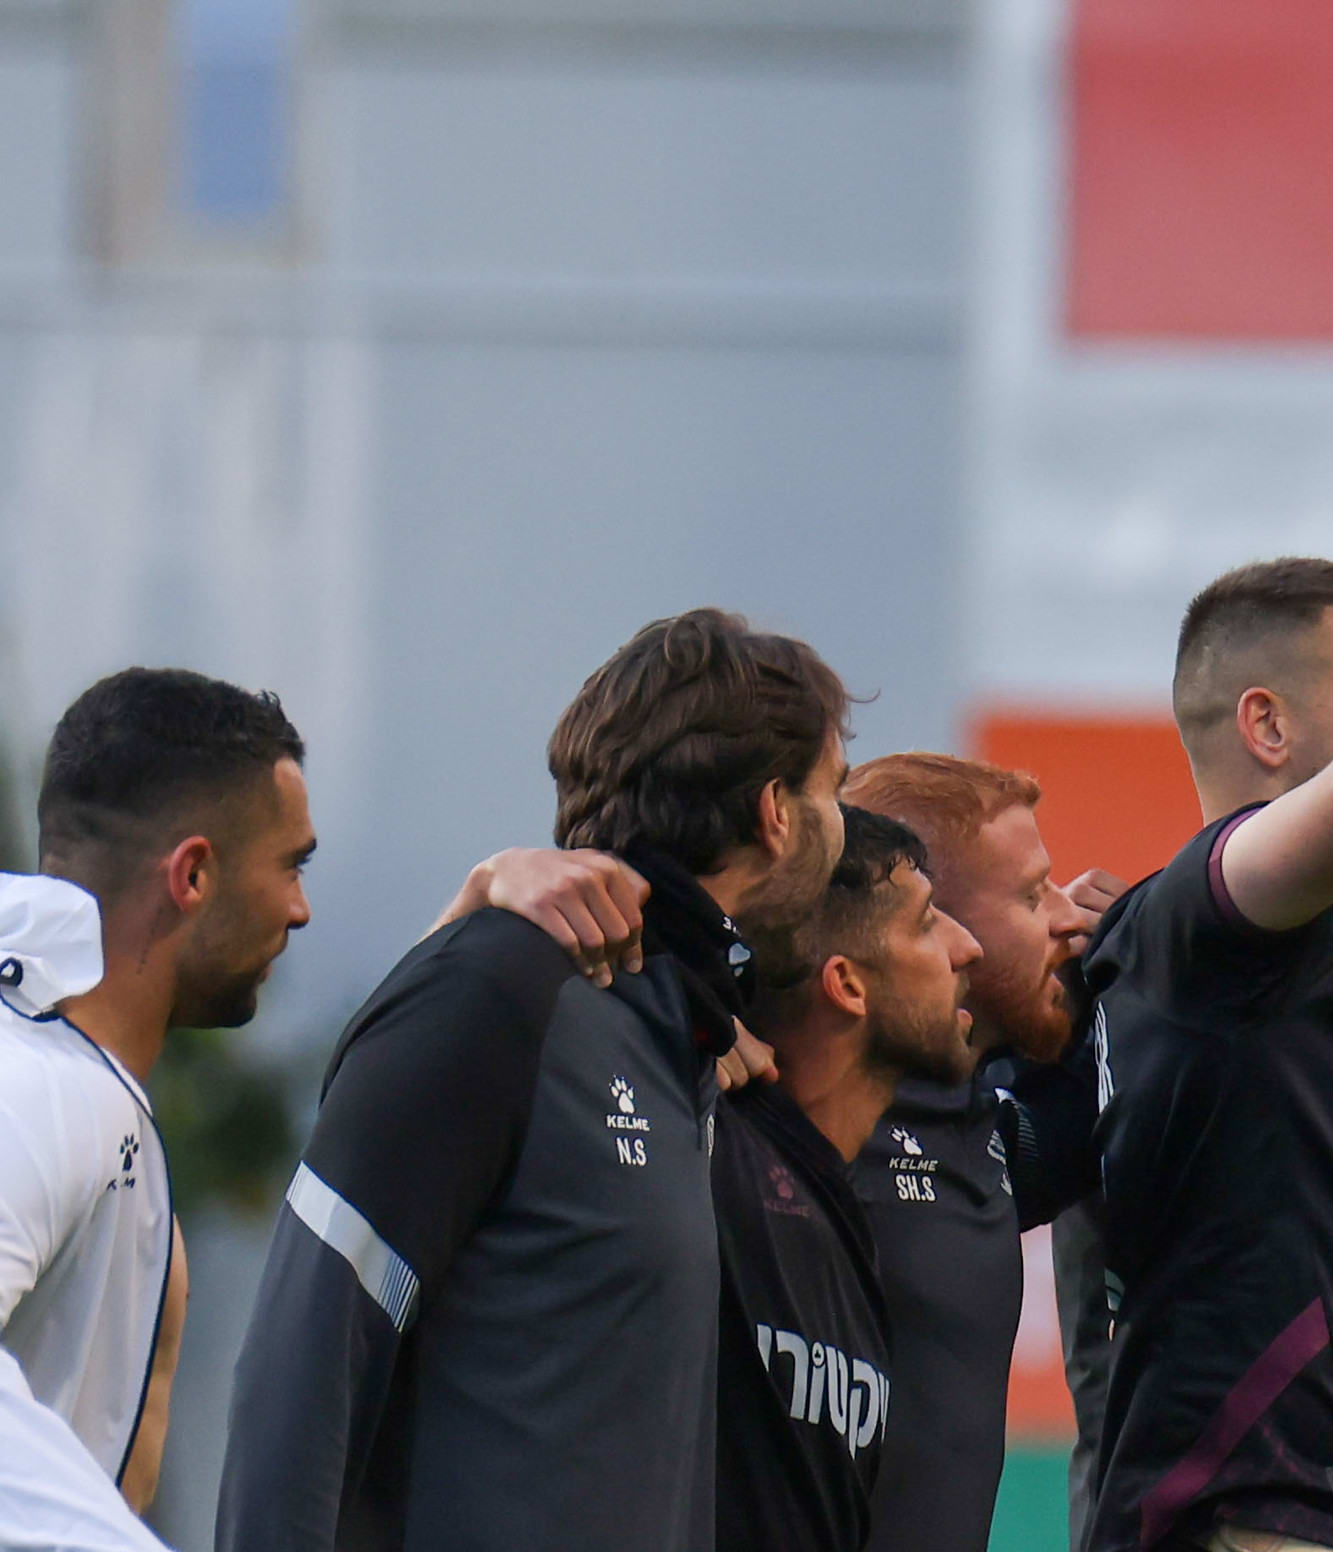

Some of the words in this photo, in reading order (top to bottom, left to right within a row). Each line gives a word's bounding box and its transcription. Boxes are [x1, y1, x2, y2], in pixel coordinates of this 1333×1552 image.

[606, 1114, 650, 1131] KELME
[615, 1137, 647, 1166] N.S
[889, 1157, 938, 1172] KELME
[895, 1174, 936, 1201] SH.S
